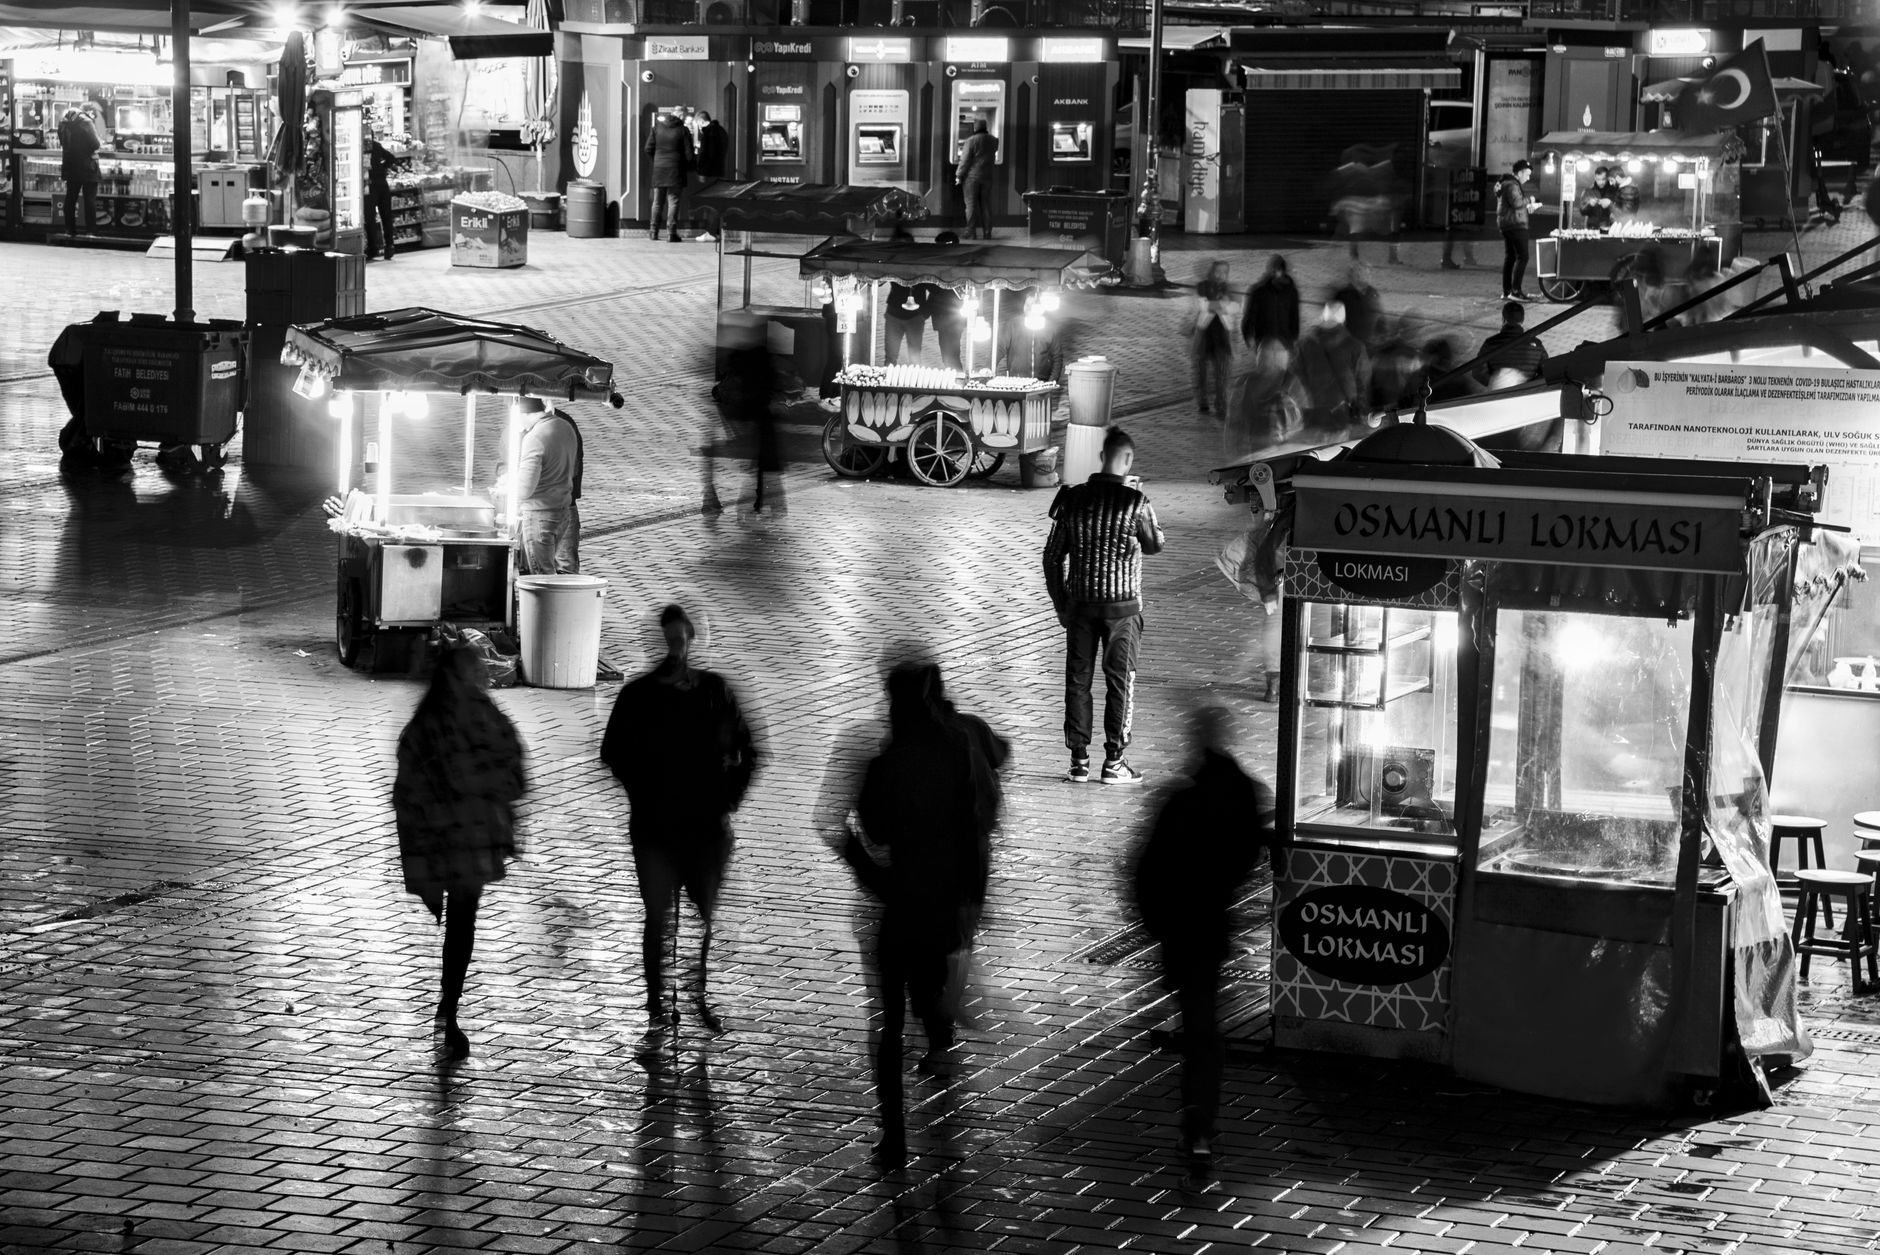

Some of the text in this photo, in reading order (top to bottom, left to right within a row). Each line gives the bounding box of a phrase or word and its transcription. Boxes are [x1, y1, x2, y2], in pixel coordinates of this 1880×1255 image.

[773, 42, 812, 55] YapıKredi
[776, 86, 803, 95] YapıKredi
[461, 216, 489, 229] Erikli
[1451, 208, 1476, 223] Soda
[1654, 373, 1661, 381] BU
[1753, 376, 1767, 385] NOLU
[1768, 375, 1793, 386] TEKNENİN
[1795, 377, 1820, 387] COVID-19
[1686, 385, 1713, 396] PERİYODİK
[1714, 387, 1734, 396] OLARAK
[1760, 389, 1767, 398] VE
[1628, 422, 1682, 432] TARAFINDAN
[1683, 424, 1754, 435] NANOTEKNOLOJİ
[1755, 427, 1821, 439] KULLANILARAK,
[1842, 430, 1872, 440] SOĞUK
[1747, 437, 1770, 445] DÜNYA
[1771, 438, 1795, 446] SAĞLIK
[1826, 441, 1848, 449] (WHO)
[1747, 444, 1780, 452] ŞARTLARA
[1334, 503, 1703, 556] OSMANLI LOKMASI
[1335, 562, 1409, 582] LOKMASI
[1300, 902, 1428, 934] OSMANLI
[1302, 933, 1425, 966] LOKMASI
